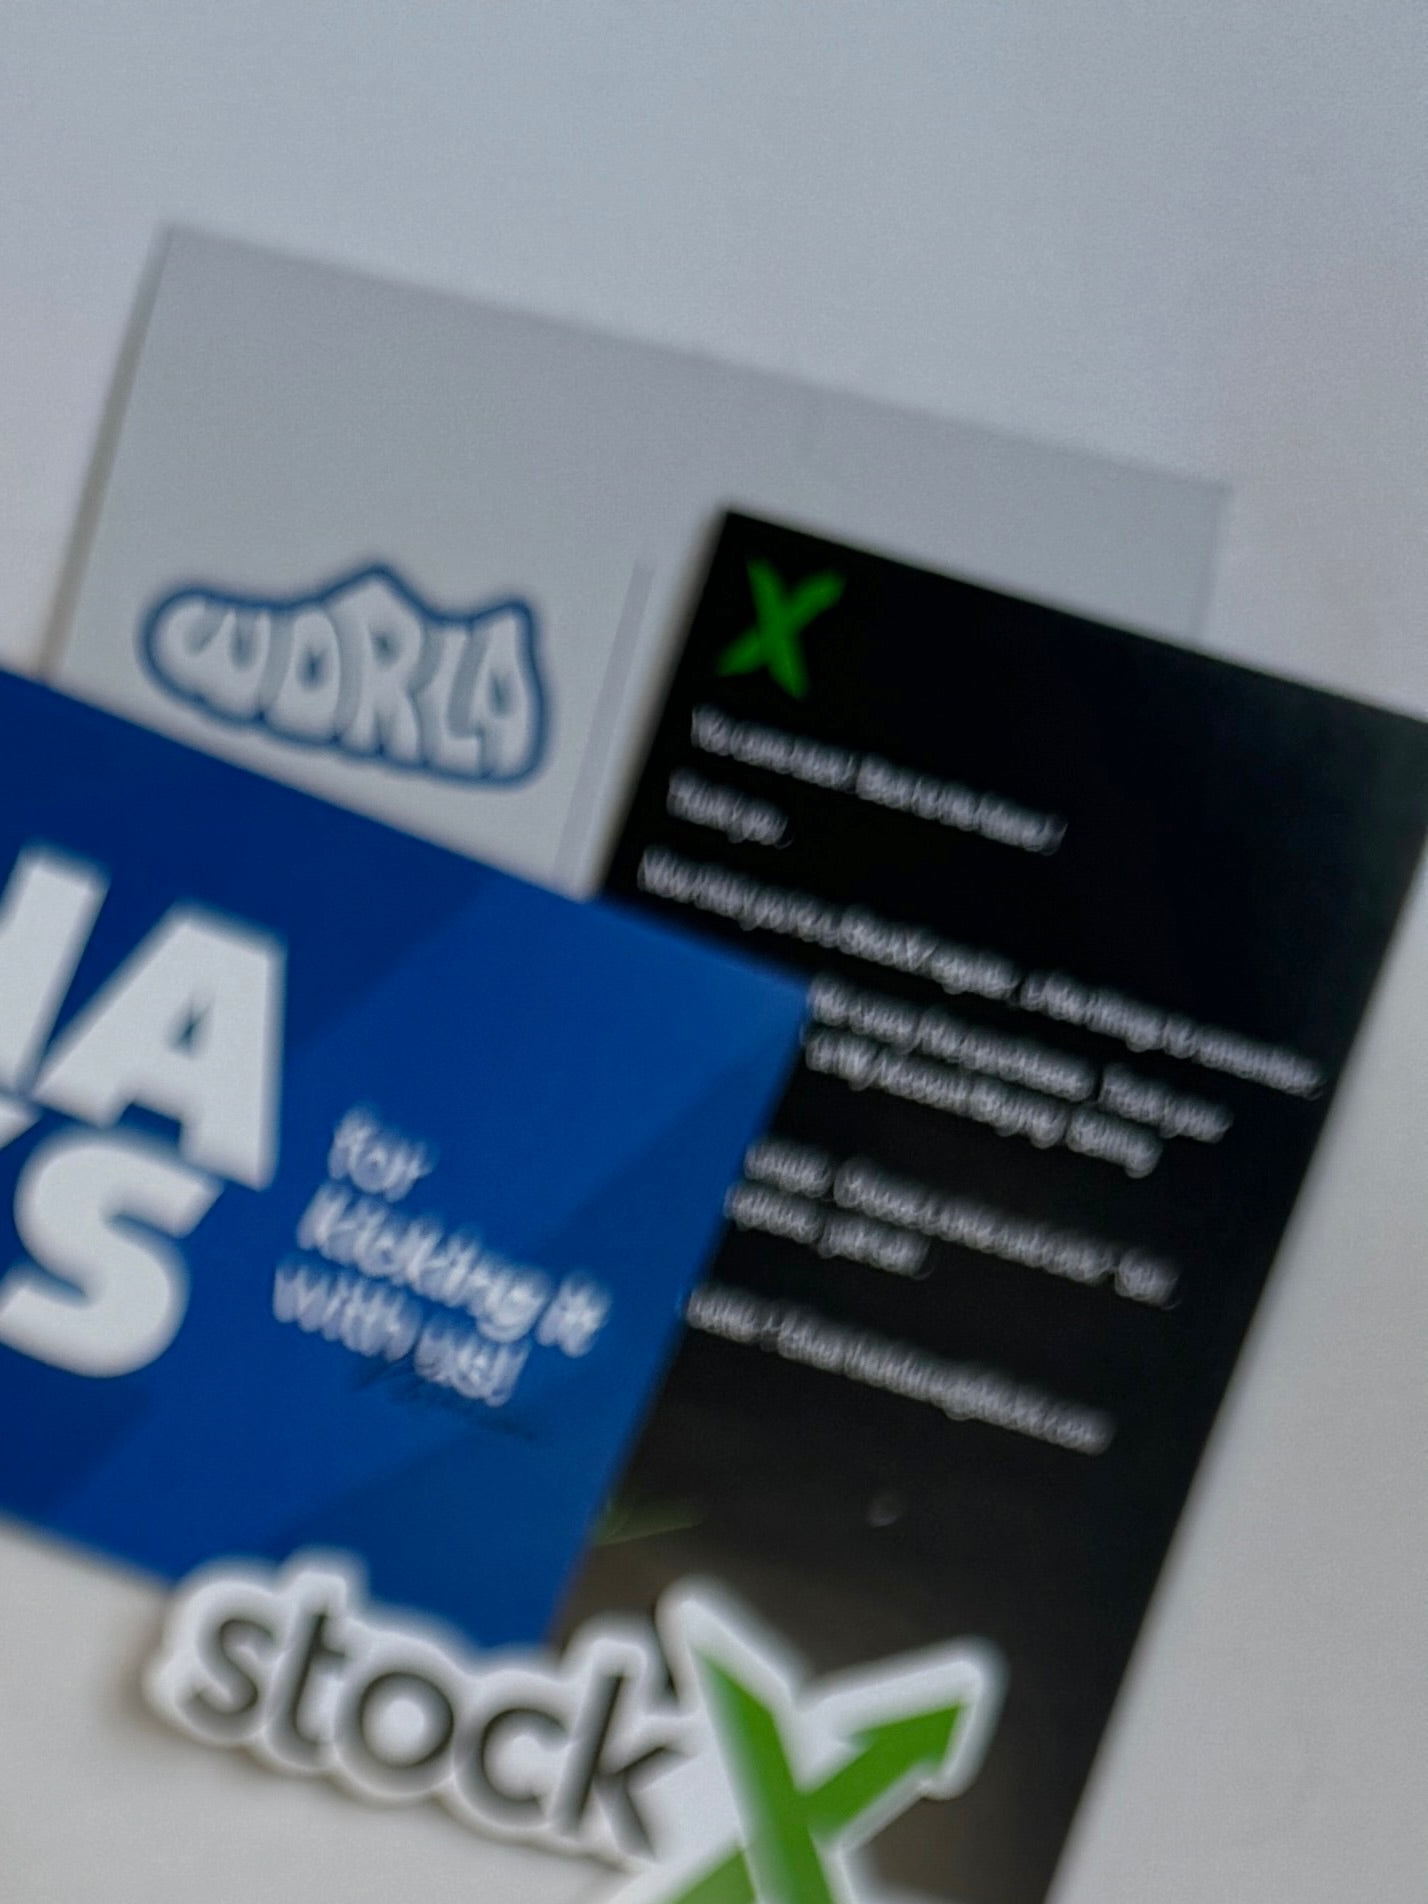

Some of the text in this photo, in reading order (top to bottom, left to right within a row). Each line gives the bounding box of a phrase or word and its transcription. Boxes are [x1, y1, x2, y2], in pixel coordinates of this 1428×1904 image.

[329, 1106, 436, 1202] for
[273, 1258, 423, 1360] with
[297, 1180, 612, 1357] kicking it
